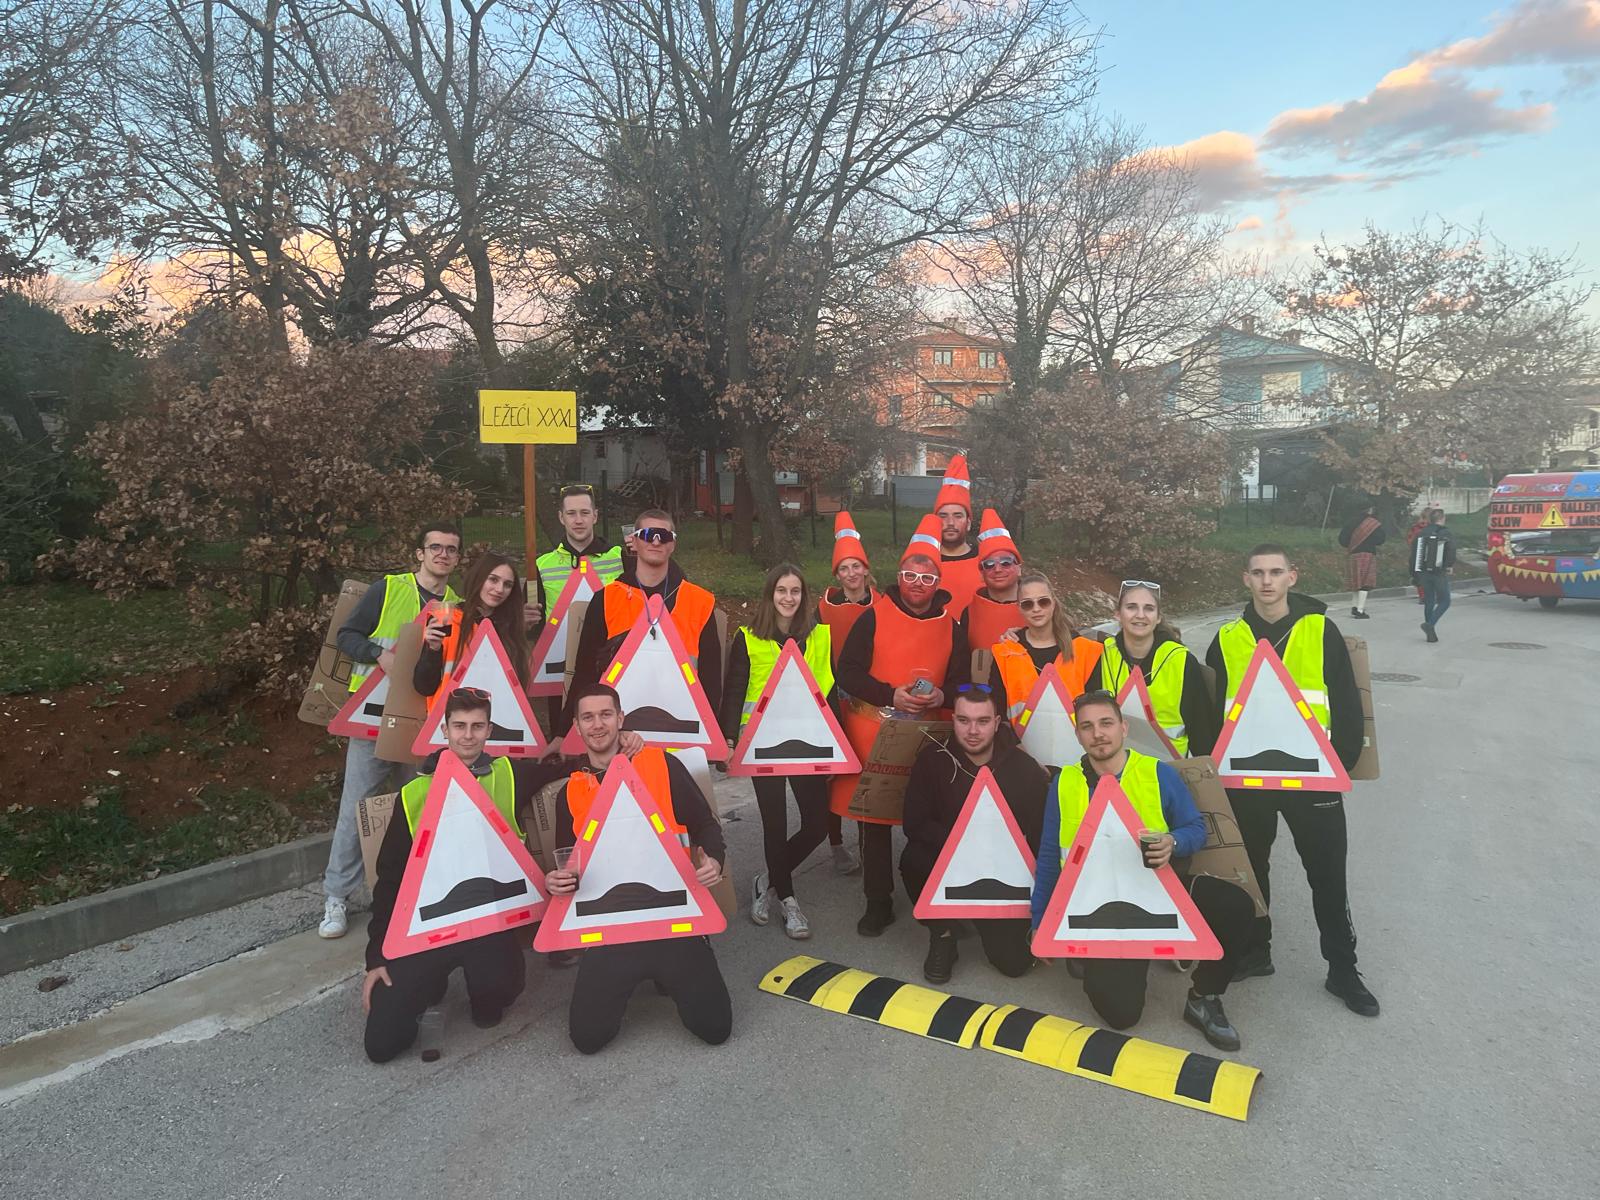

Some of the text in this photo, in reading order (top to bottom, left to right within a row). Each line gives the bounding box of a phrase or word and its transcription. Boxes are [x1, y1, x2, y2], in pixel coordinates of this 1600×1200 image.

[482, 403, 577, 428] LEŽEĆI XXXL
[1490, 516, 1521, 527] SLOW
